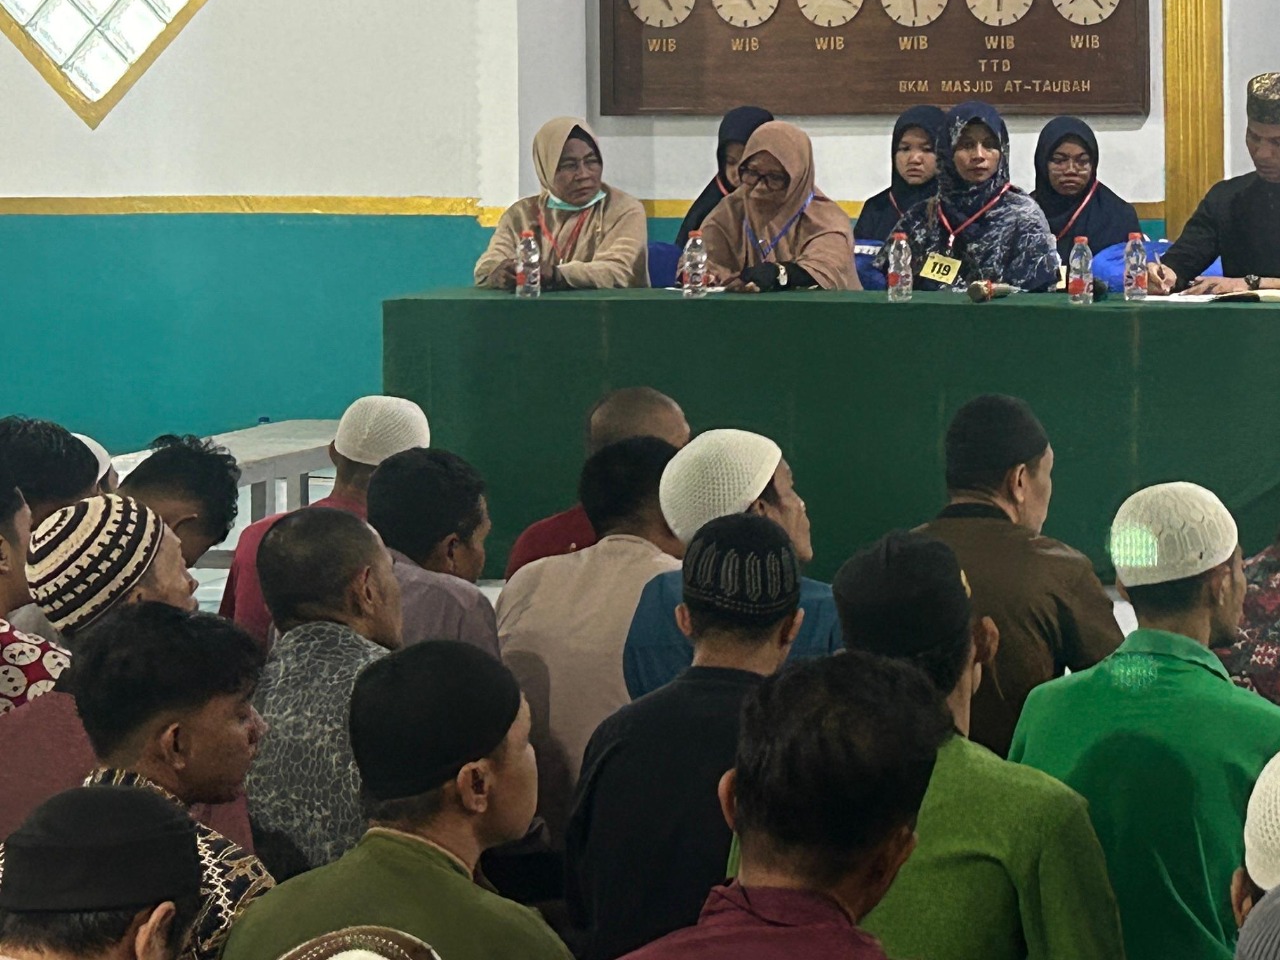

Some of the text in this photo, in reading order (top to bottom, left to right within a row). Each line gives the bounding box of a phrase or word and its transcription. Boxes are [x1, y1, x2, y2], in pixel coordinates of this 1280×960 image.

[648, 38, 677, 52] WIB
[731, 37, 760, 52] WIB
[815, 36, 845, 51] WIB
[898, 35, 929, 50] WIB
[985, 35, 1016, 50] WIB
[1070, 34, 1100, 49] WIB
[978, 59, 1011, 72] TTD
[899, 79, 1091, 93] BKM MASJID AT-TAUBAH
[930, 261, 952, 276] 119
